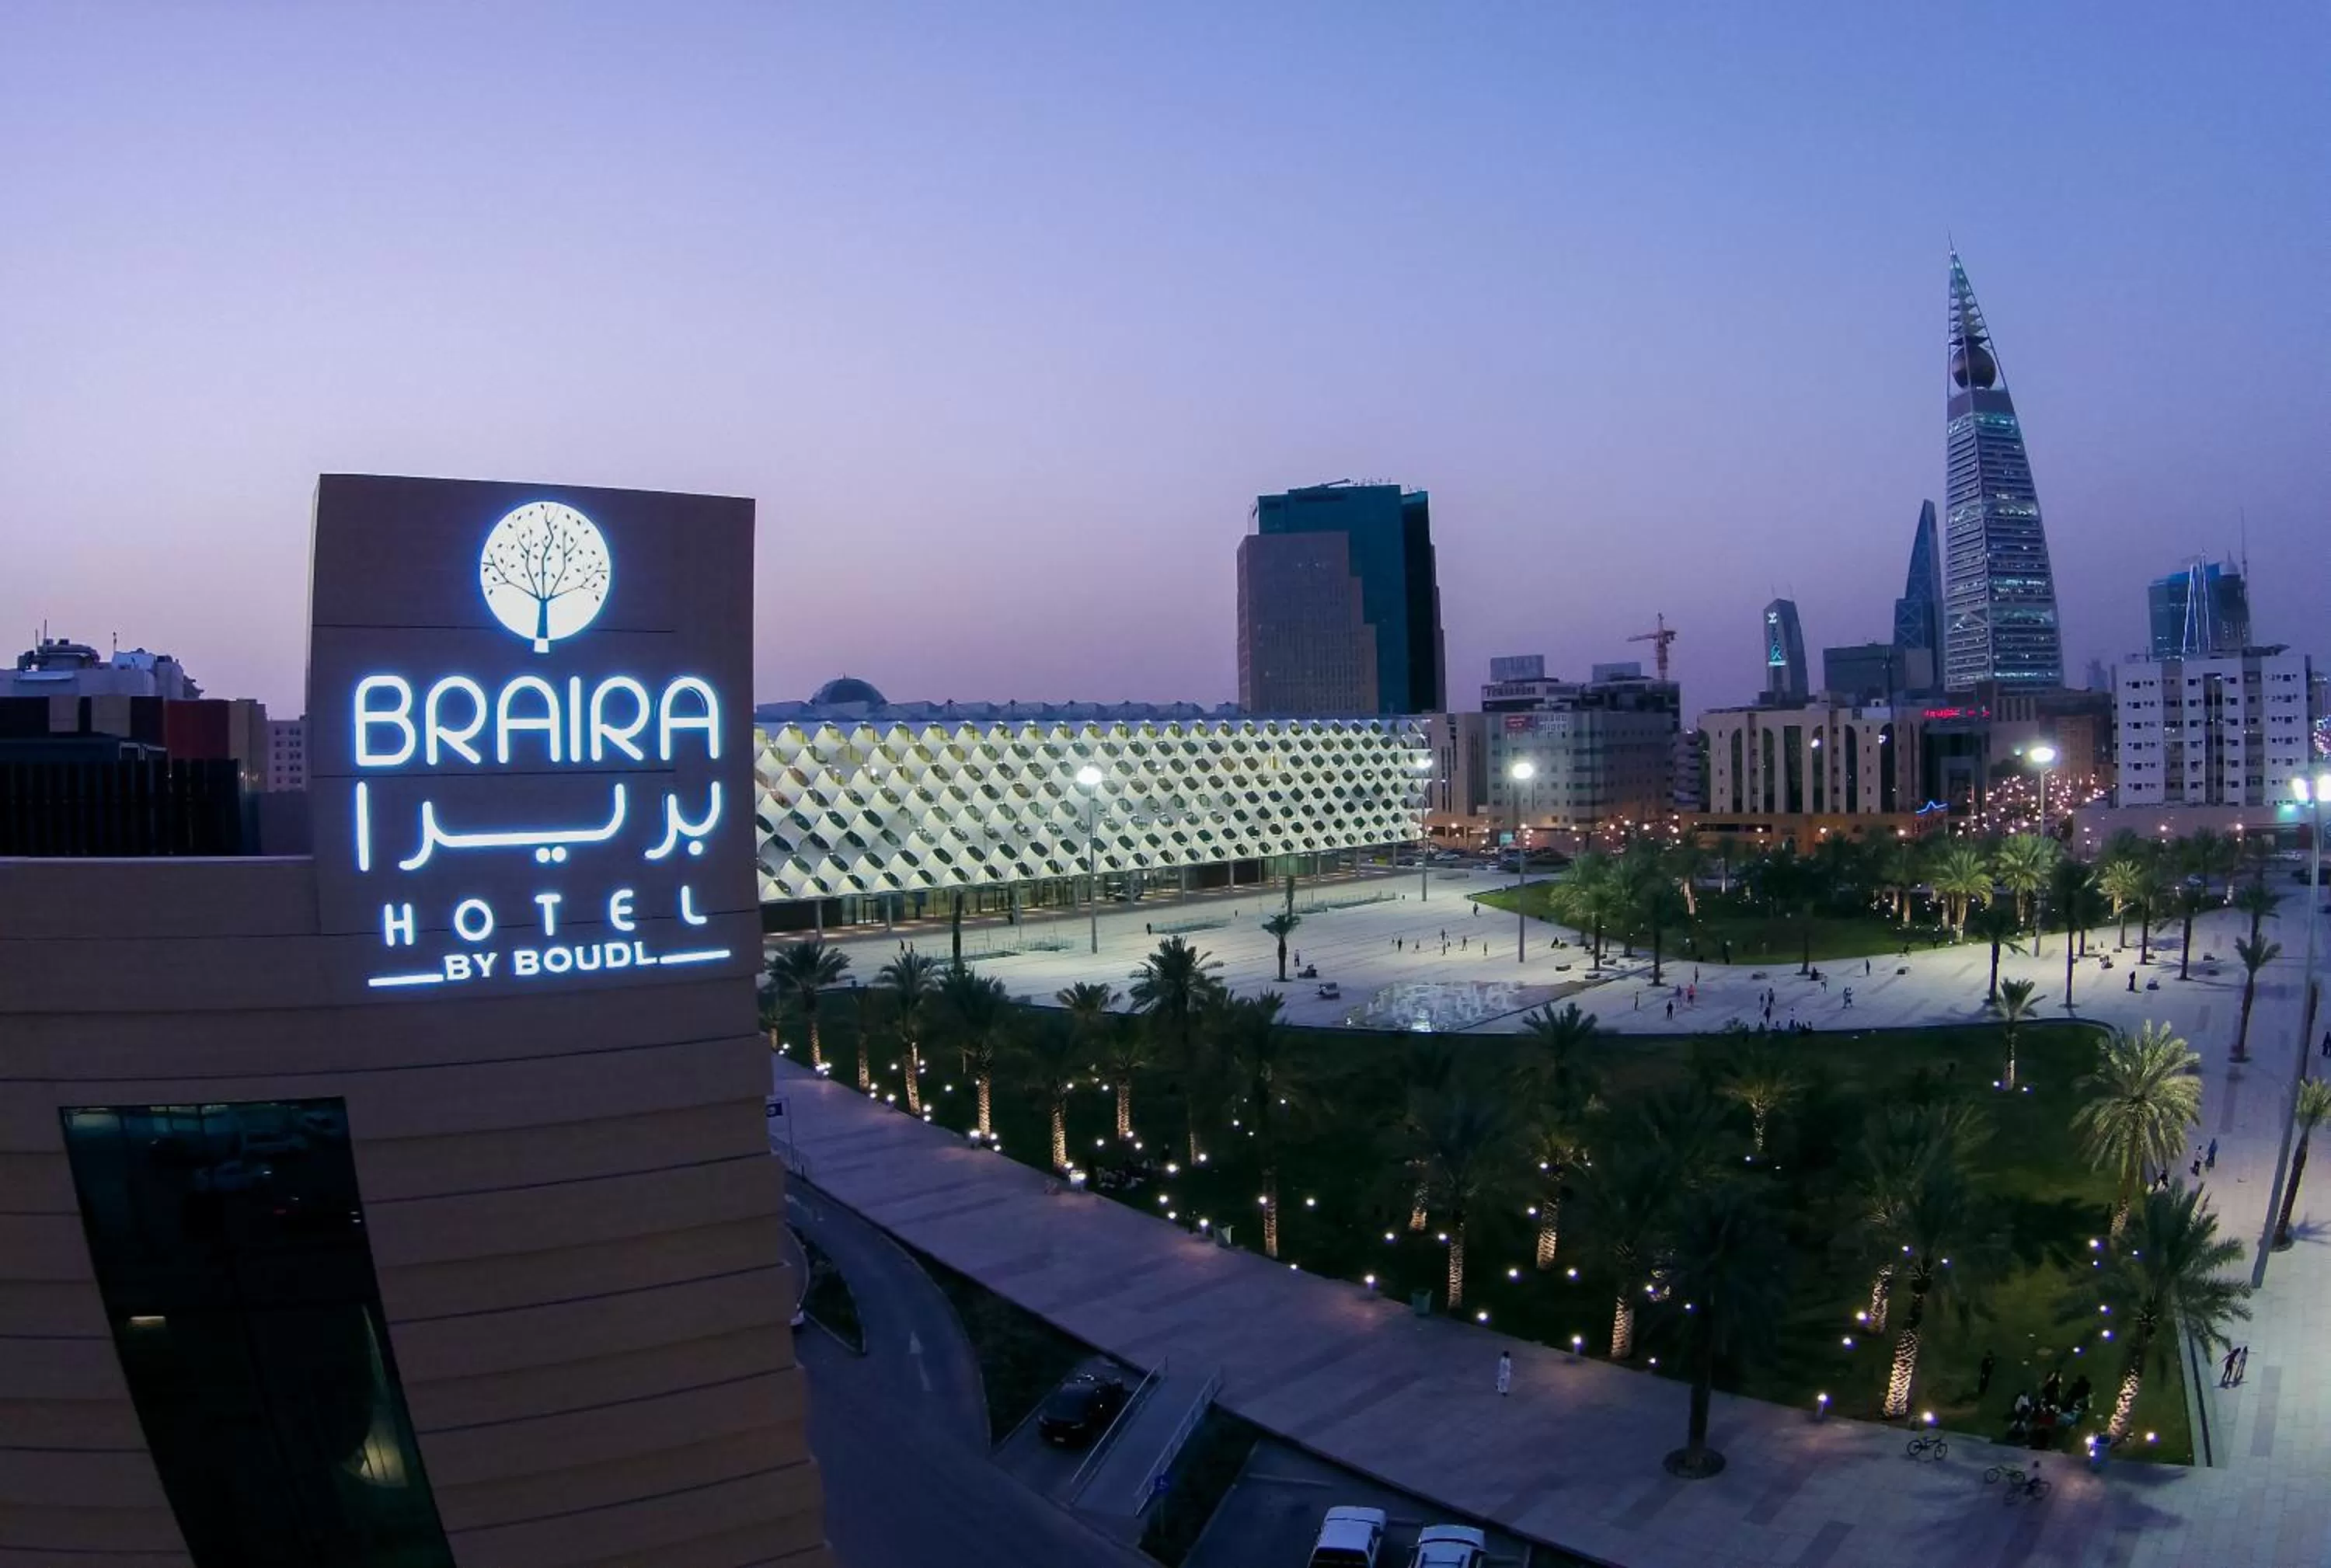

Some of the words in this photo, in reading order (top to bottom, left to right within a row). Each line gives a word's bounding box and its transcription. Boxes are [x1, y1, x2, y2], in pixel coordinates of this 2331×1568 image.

[354, 675, 720, 766] BRAIRA
[356, 781, 721, 872] بريرا
[383, 884, 707, 946] HOTEL
[444, 952, 498, 981] BY
[514, 941, 657, 975] BOUDL
